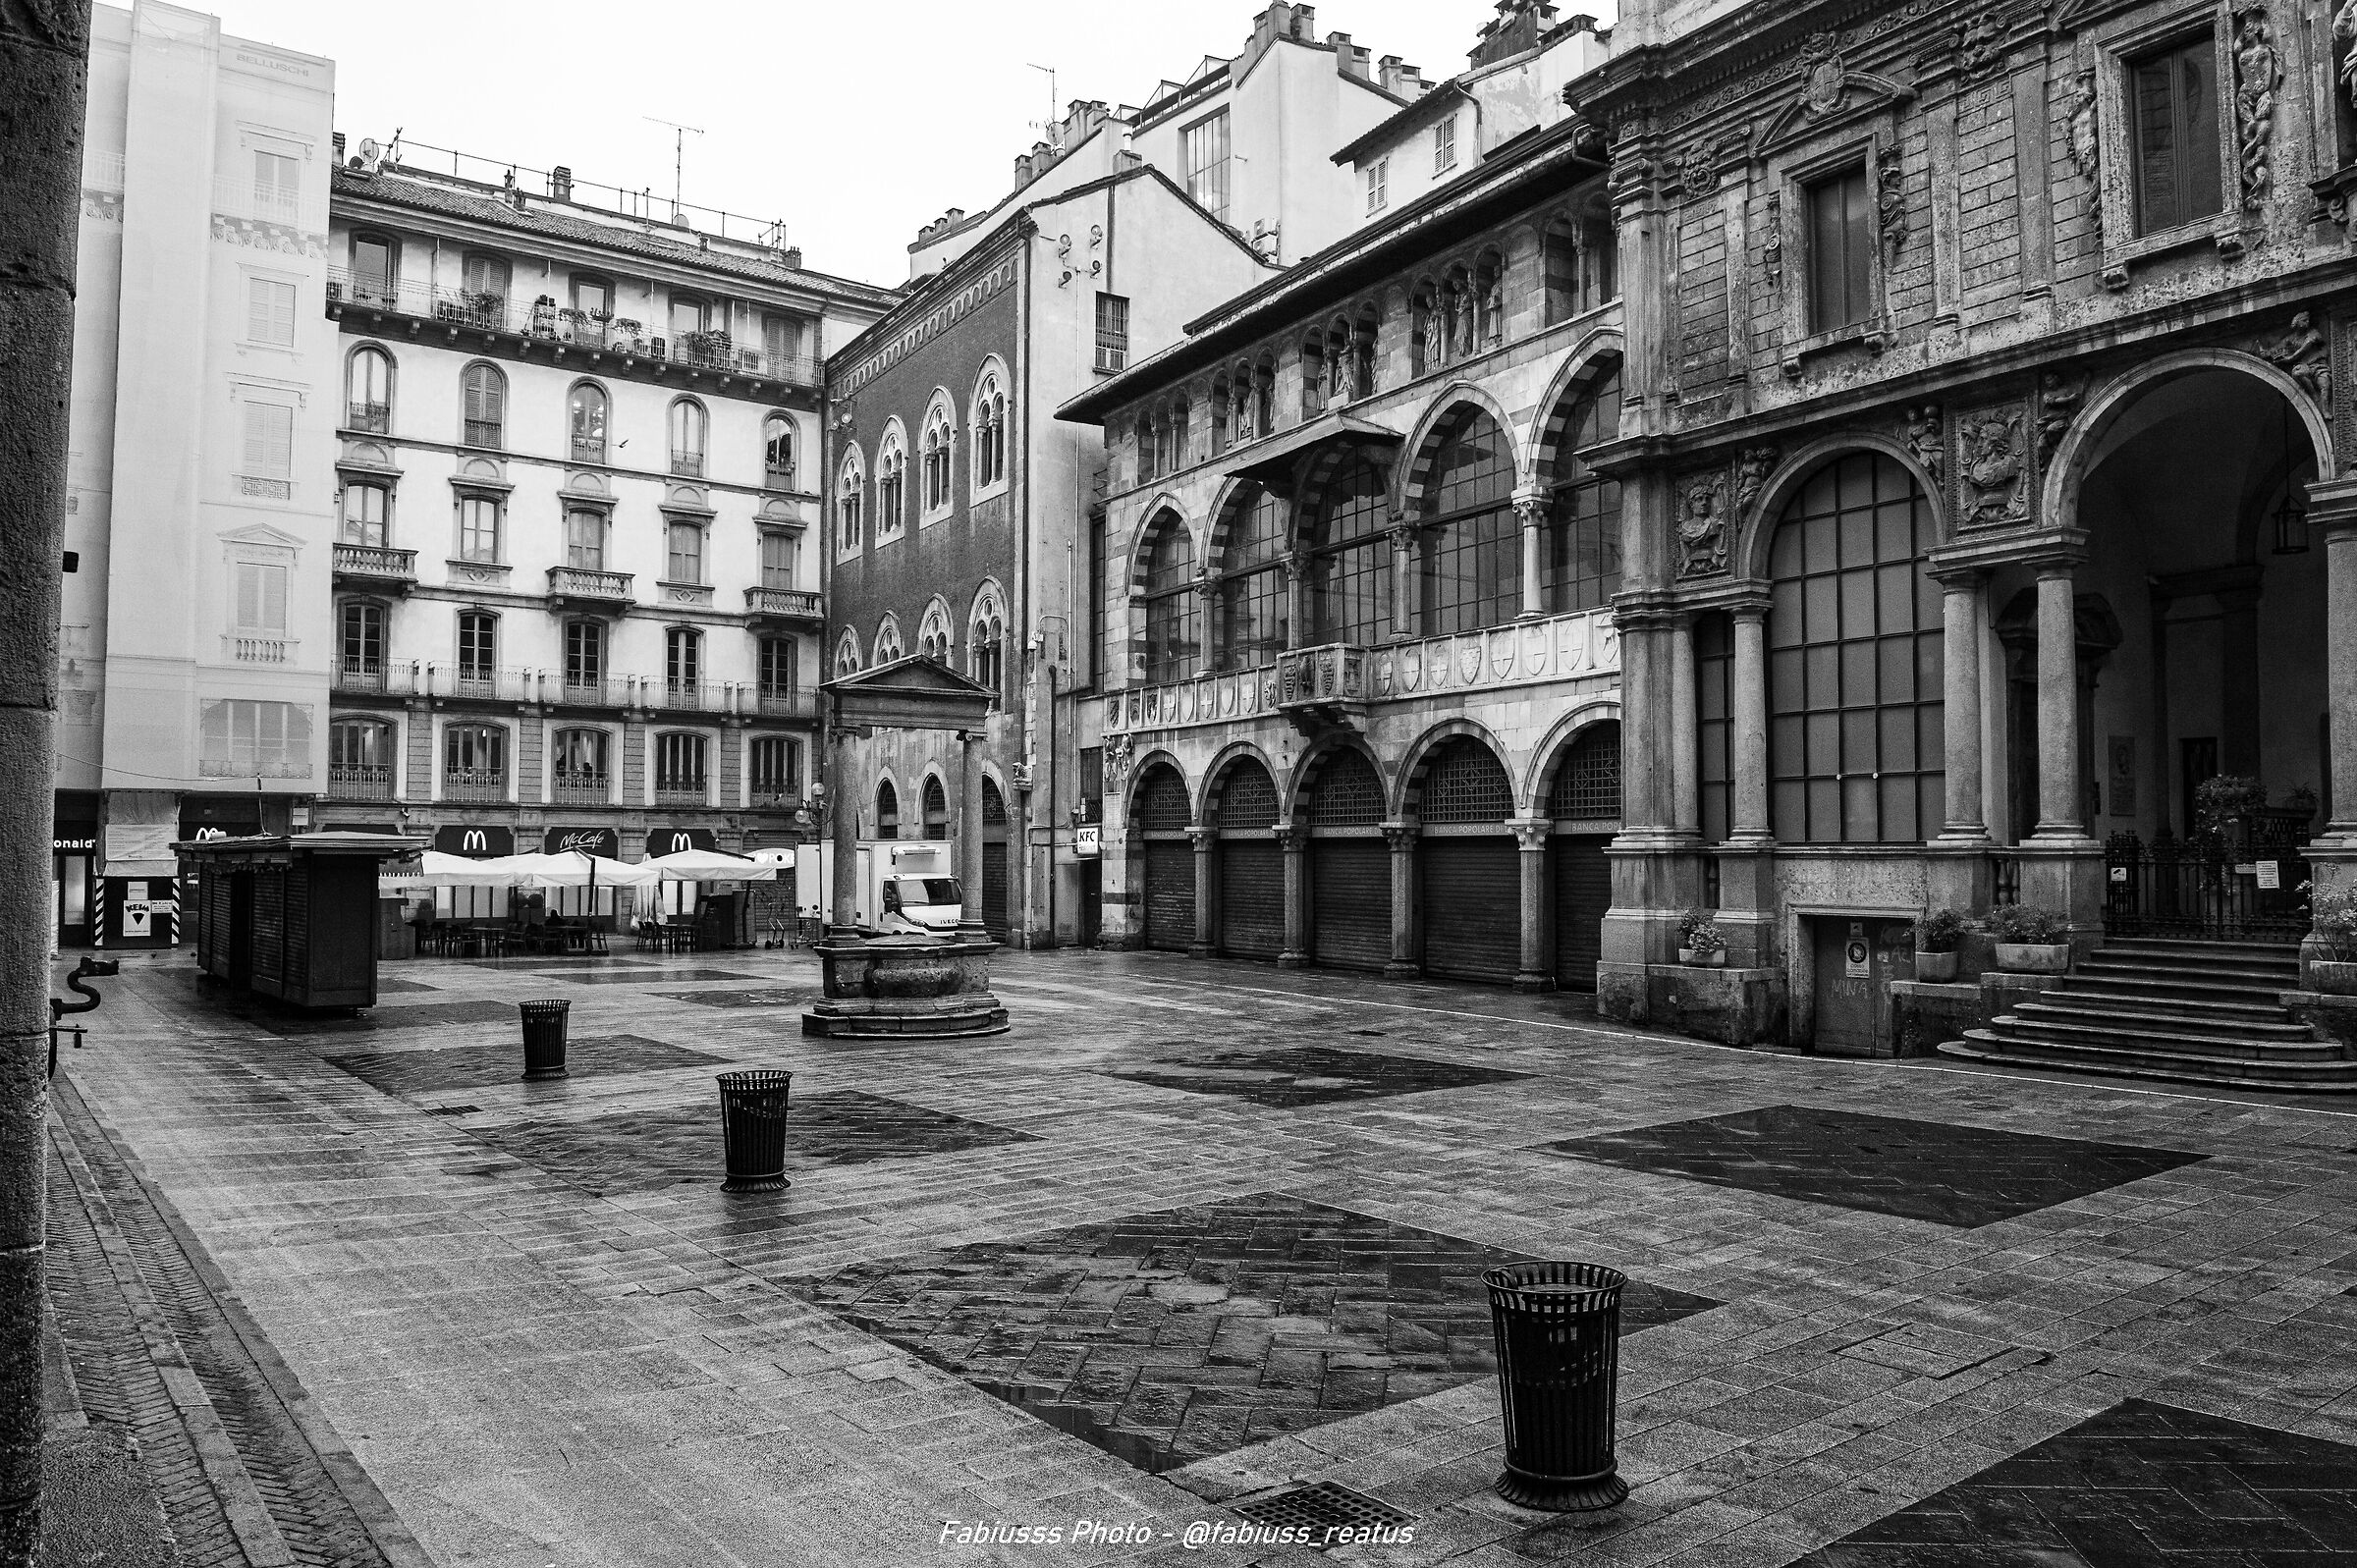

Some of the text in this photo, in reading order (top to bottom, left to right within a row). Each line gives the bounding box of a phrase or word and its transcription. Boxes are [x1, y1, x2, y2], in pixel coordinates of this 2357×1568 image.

[237, 54, 308, 77] BELLUSCHI
[1458, 825, 1493, 834] POPOLARE
[1571, 823, 1599, 832] BANCA
[1079, 831, 1095, 841] KFC
[126, 903, 149, 912] KEIM
